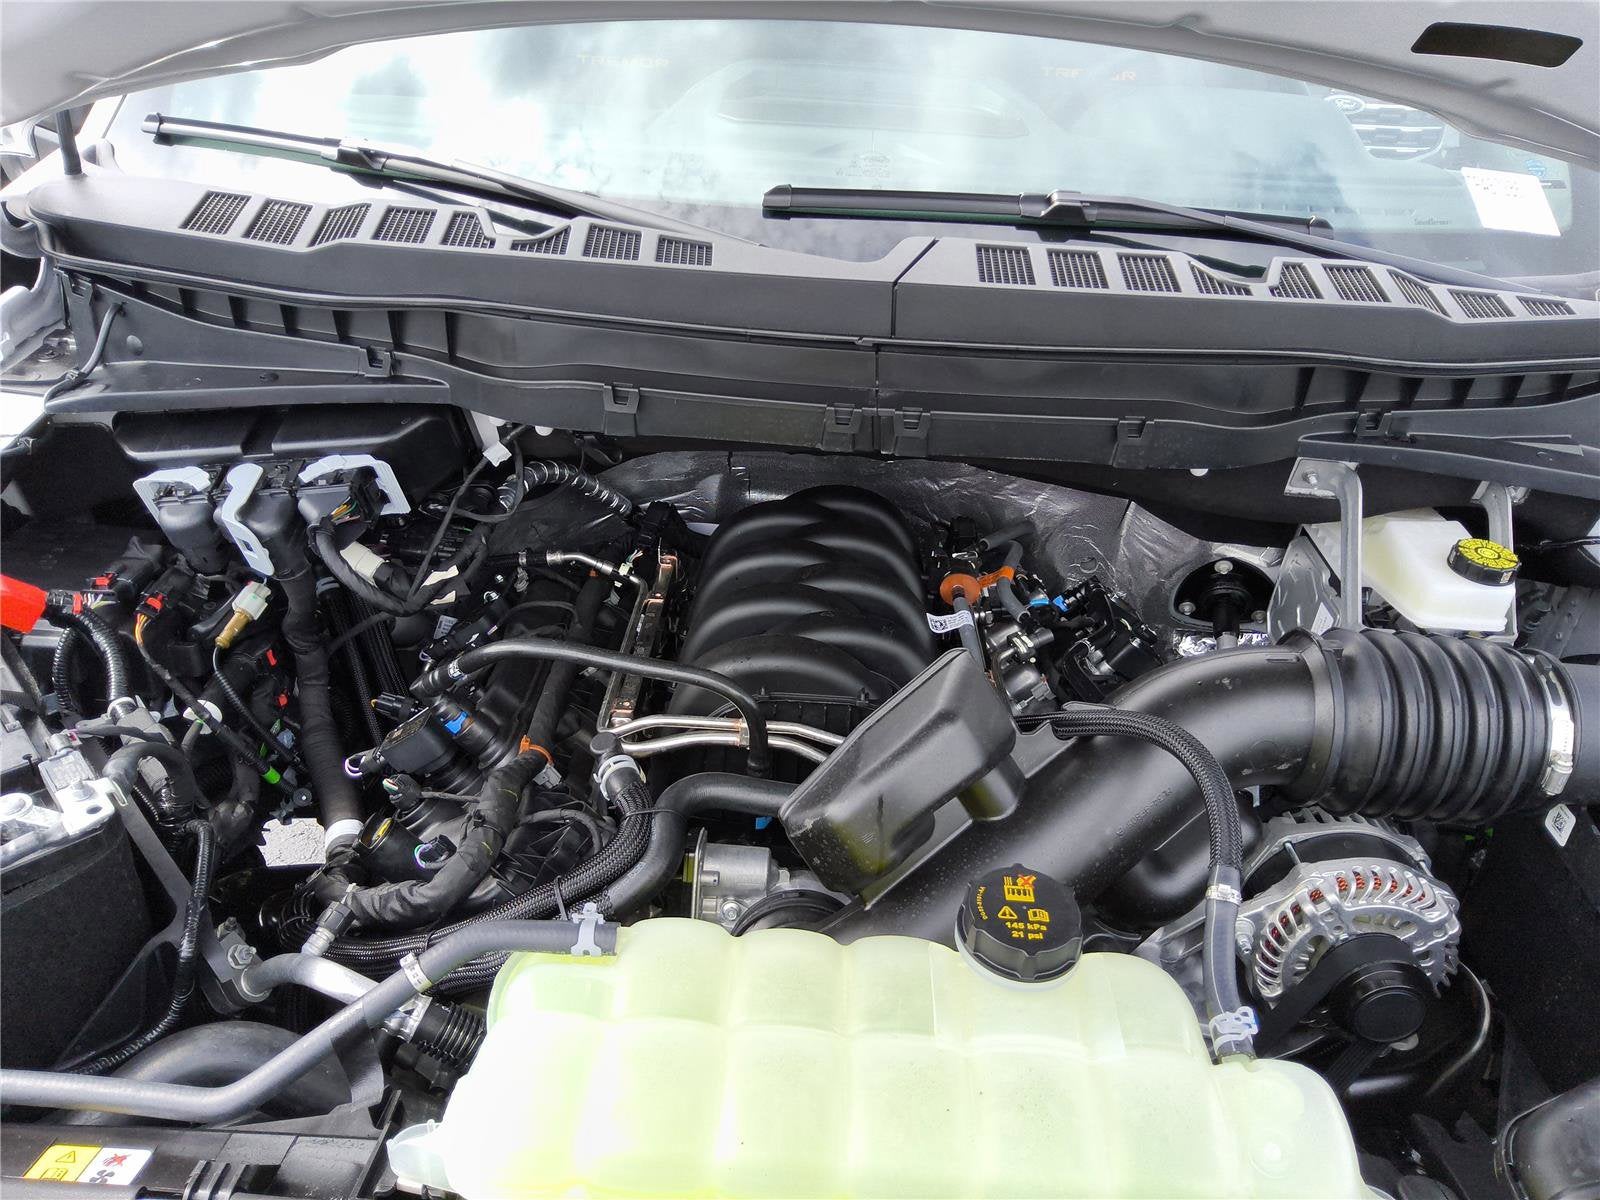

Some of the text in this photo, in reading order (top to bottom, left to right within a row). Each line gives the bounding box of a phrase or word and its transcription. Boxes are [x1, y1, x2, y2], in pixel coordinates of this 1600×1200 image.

[1040, 66, 1136, 80] TRER
[1005, 921, 1047, 931] 145 kPa
[1011, 930, 1043, 940] 21 psi
